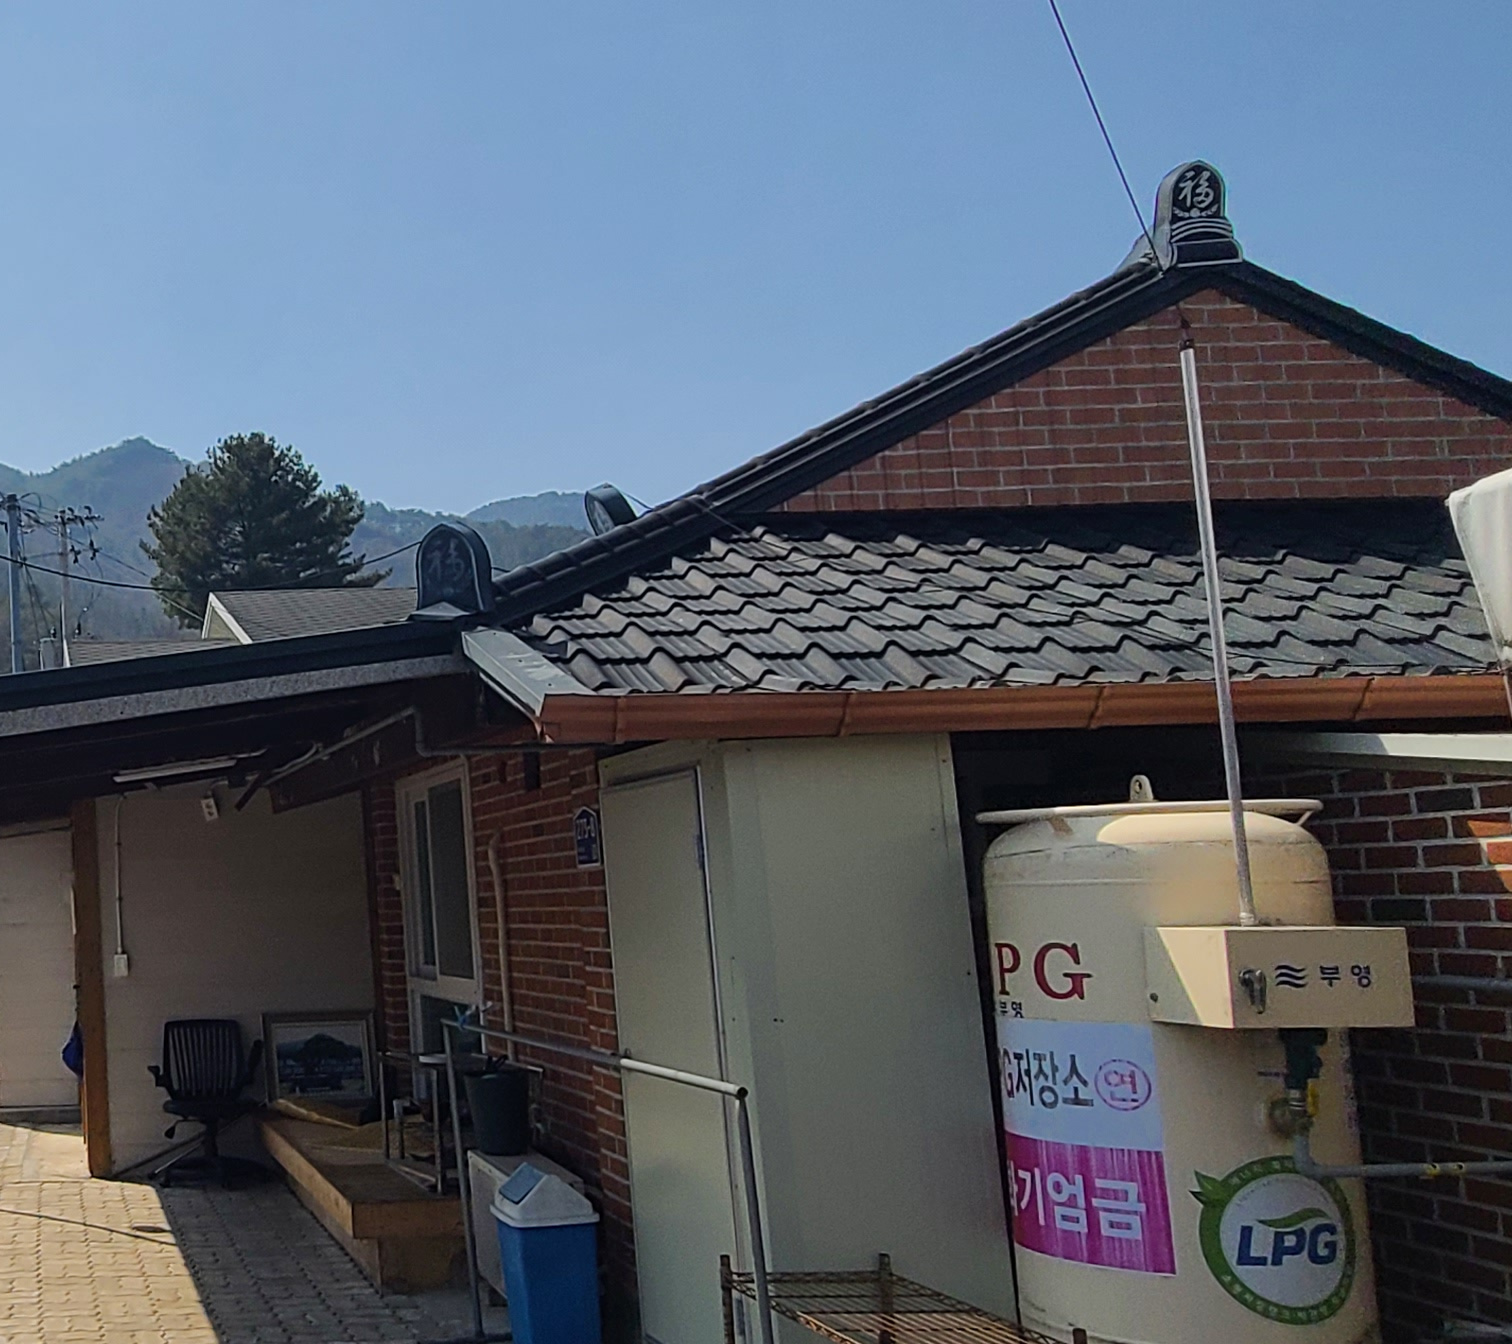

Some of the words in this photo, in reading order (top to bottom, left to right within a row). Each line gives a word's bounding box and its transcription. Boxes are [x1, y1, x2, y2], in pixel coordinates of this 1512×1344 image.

[1178, 170, 1215, 209] 福
[1319, 964, 1372, 988] 부영
[1001, 1047, 1094, 1109] G저장소
[1236, 1222, 1338, 1267] LPG
